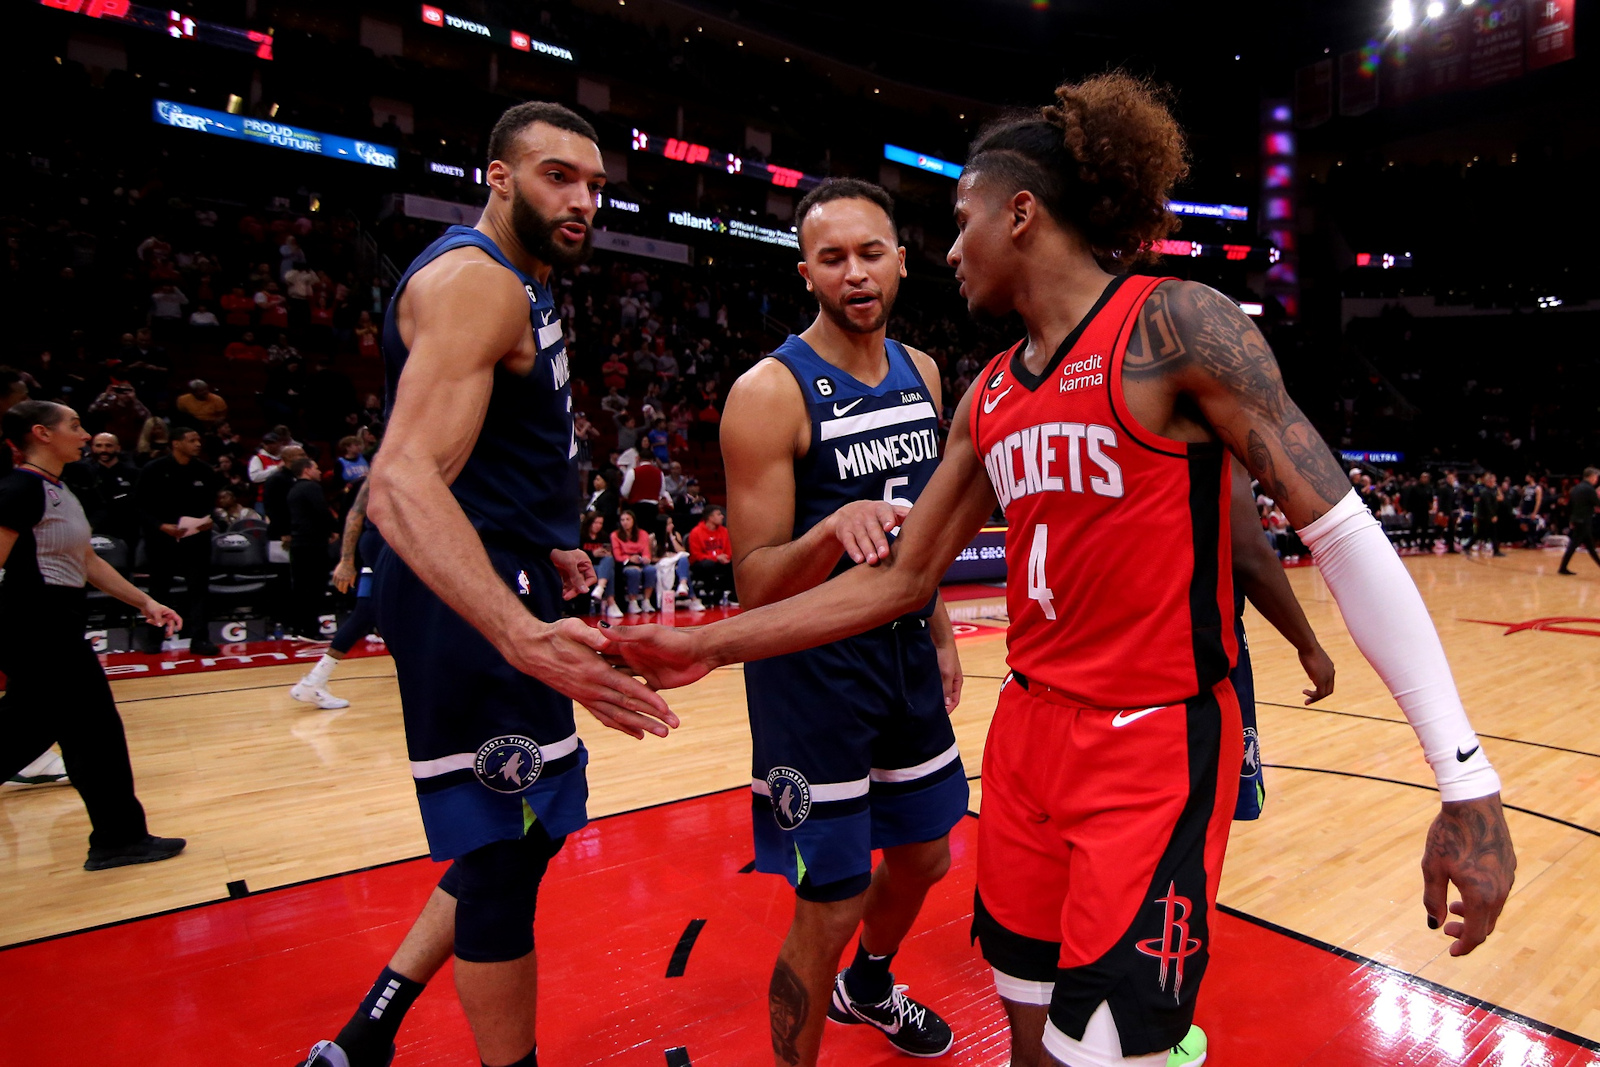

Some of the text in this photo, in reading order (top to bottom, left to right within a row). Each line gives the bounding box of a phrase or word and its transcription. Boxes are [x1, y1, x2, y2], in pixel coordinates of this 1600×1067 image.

[445, 14, 491, 37] TOYOTA
[531, 39, 573, 61] TOYOTA
[169, 111, 207, 132] KBR
[243, 118, 293, 138] PROUD
[269, 133, 322, 153] FUTURE
[664, 138, 710, 164] UP
[365, 151, 397, 169] KBR
[668, 211, 713, 231] reliant
[729, 219, 755, 233] Official
[729, 228, 739, 236] of
[738, 229, 751, 240] the
[525, 284, 537, 303] 6
[1063, 354, 1103, 376] credit
[816, 378, 833, 396] 6
[990, 371, 1005, 389] 6
[1059, 372, 1104, 394] karma
[834, 428, 938, 481] MINNESOTA
[1369, 453, 1398, 463] ULTRA
[1027, 523, 1057, 621] 4
[221, 621, 248, 642] G
[476, 738, 541, 781] MINNESOTA TIMBERWOLVES
[781, 769, 810, 820] TIMBERWOLVES
